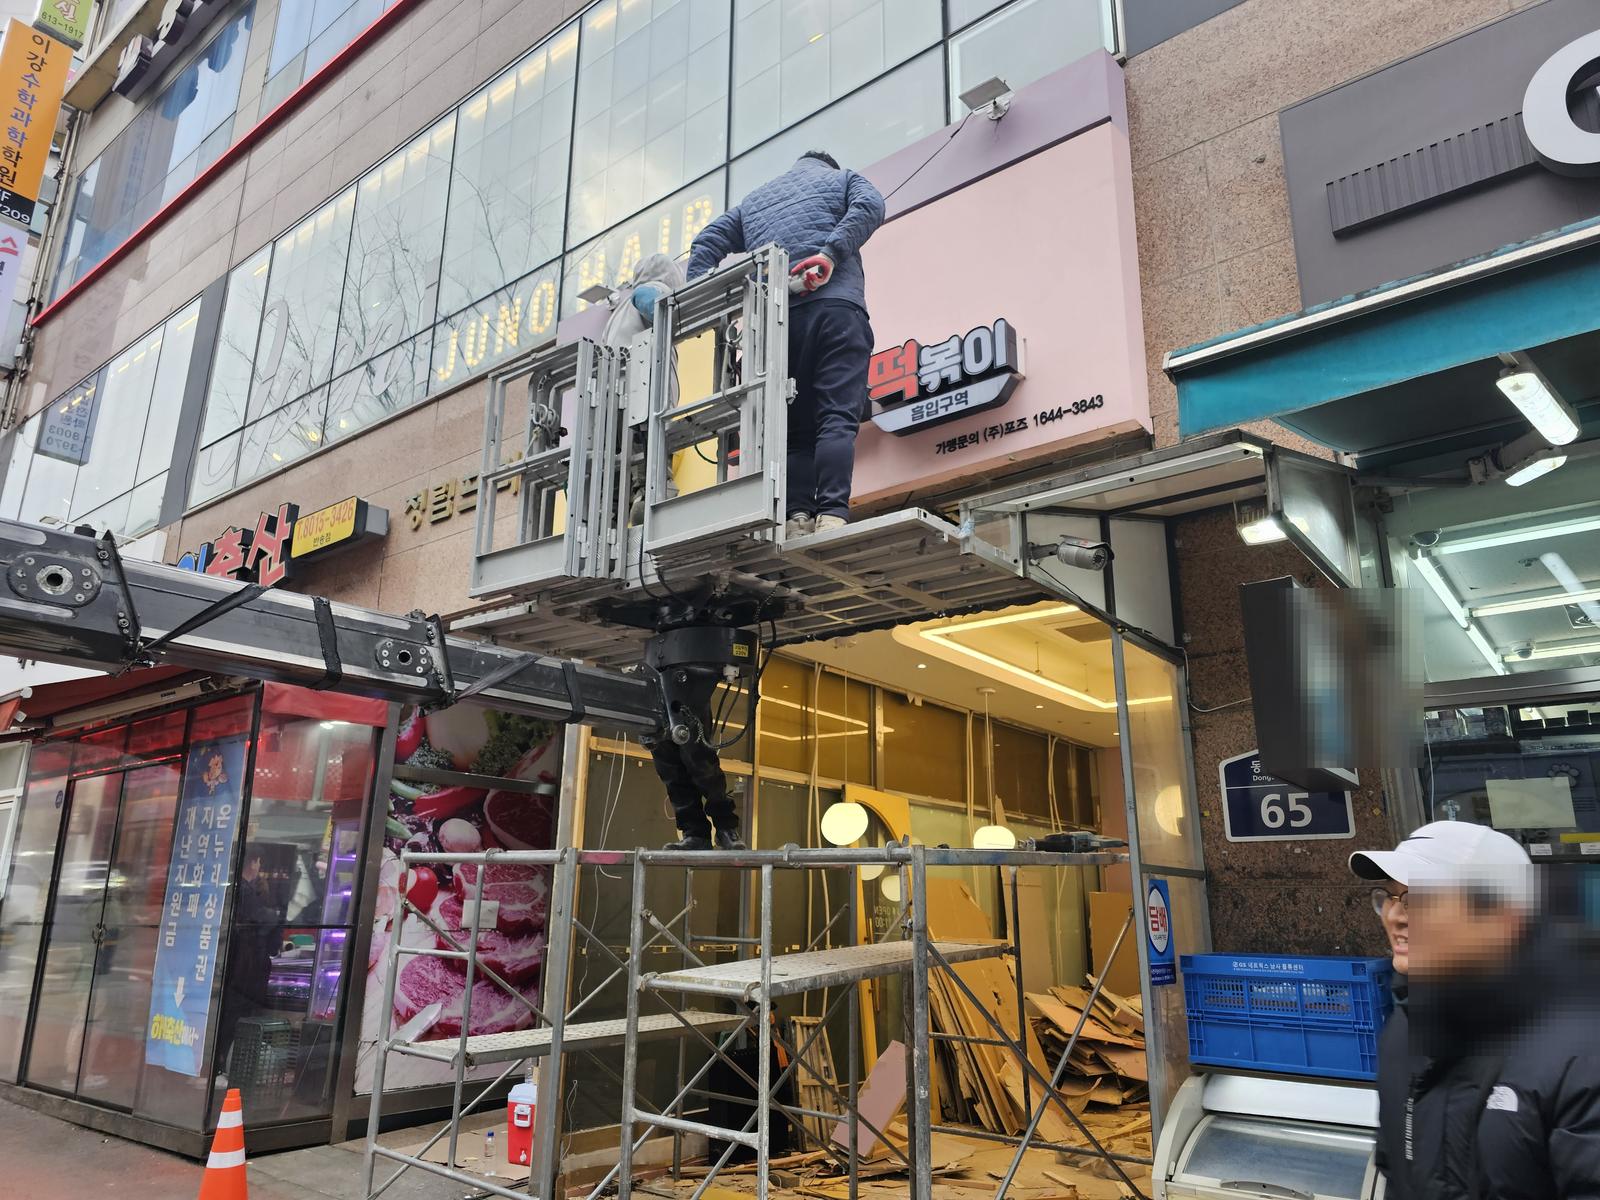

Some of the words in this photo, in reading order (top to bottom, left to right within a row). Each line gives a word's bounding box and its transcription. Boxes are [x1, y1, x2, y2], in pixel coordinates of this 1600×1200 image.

[41, 11, 84, 38] 613-1917
[436, 281, 555, 382] JUNO
[577, 196, 713, 312] HAIR
[868, 318, 1012, 400] 떡볶이
[911, 390, 968, 421] 흡입구역
[936, 431, 979, 454] 가맹문의
[984, 417, 1028, 442] (주)포즈
[1033, 395, 1104, 427] 1644-3843
[296, 500, 354, 541] T.8015-3426
[1260, 792, 1313, 829] 65
